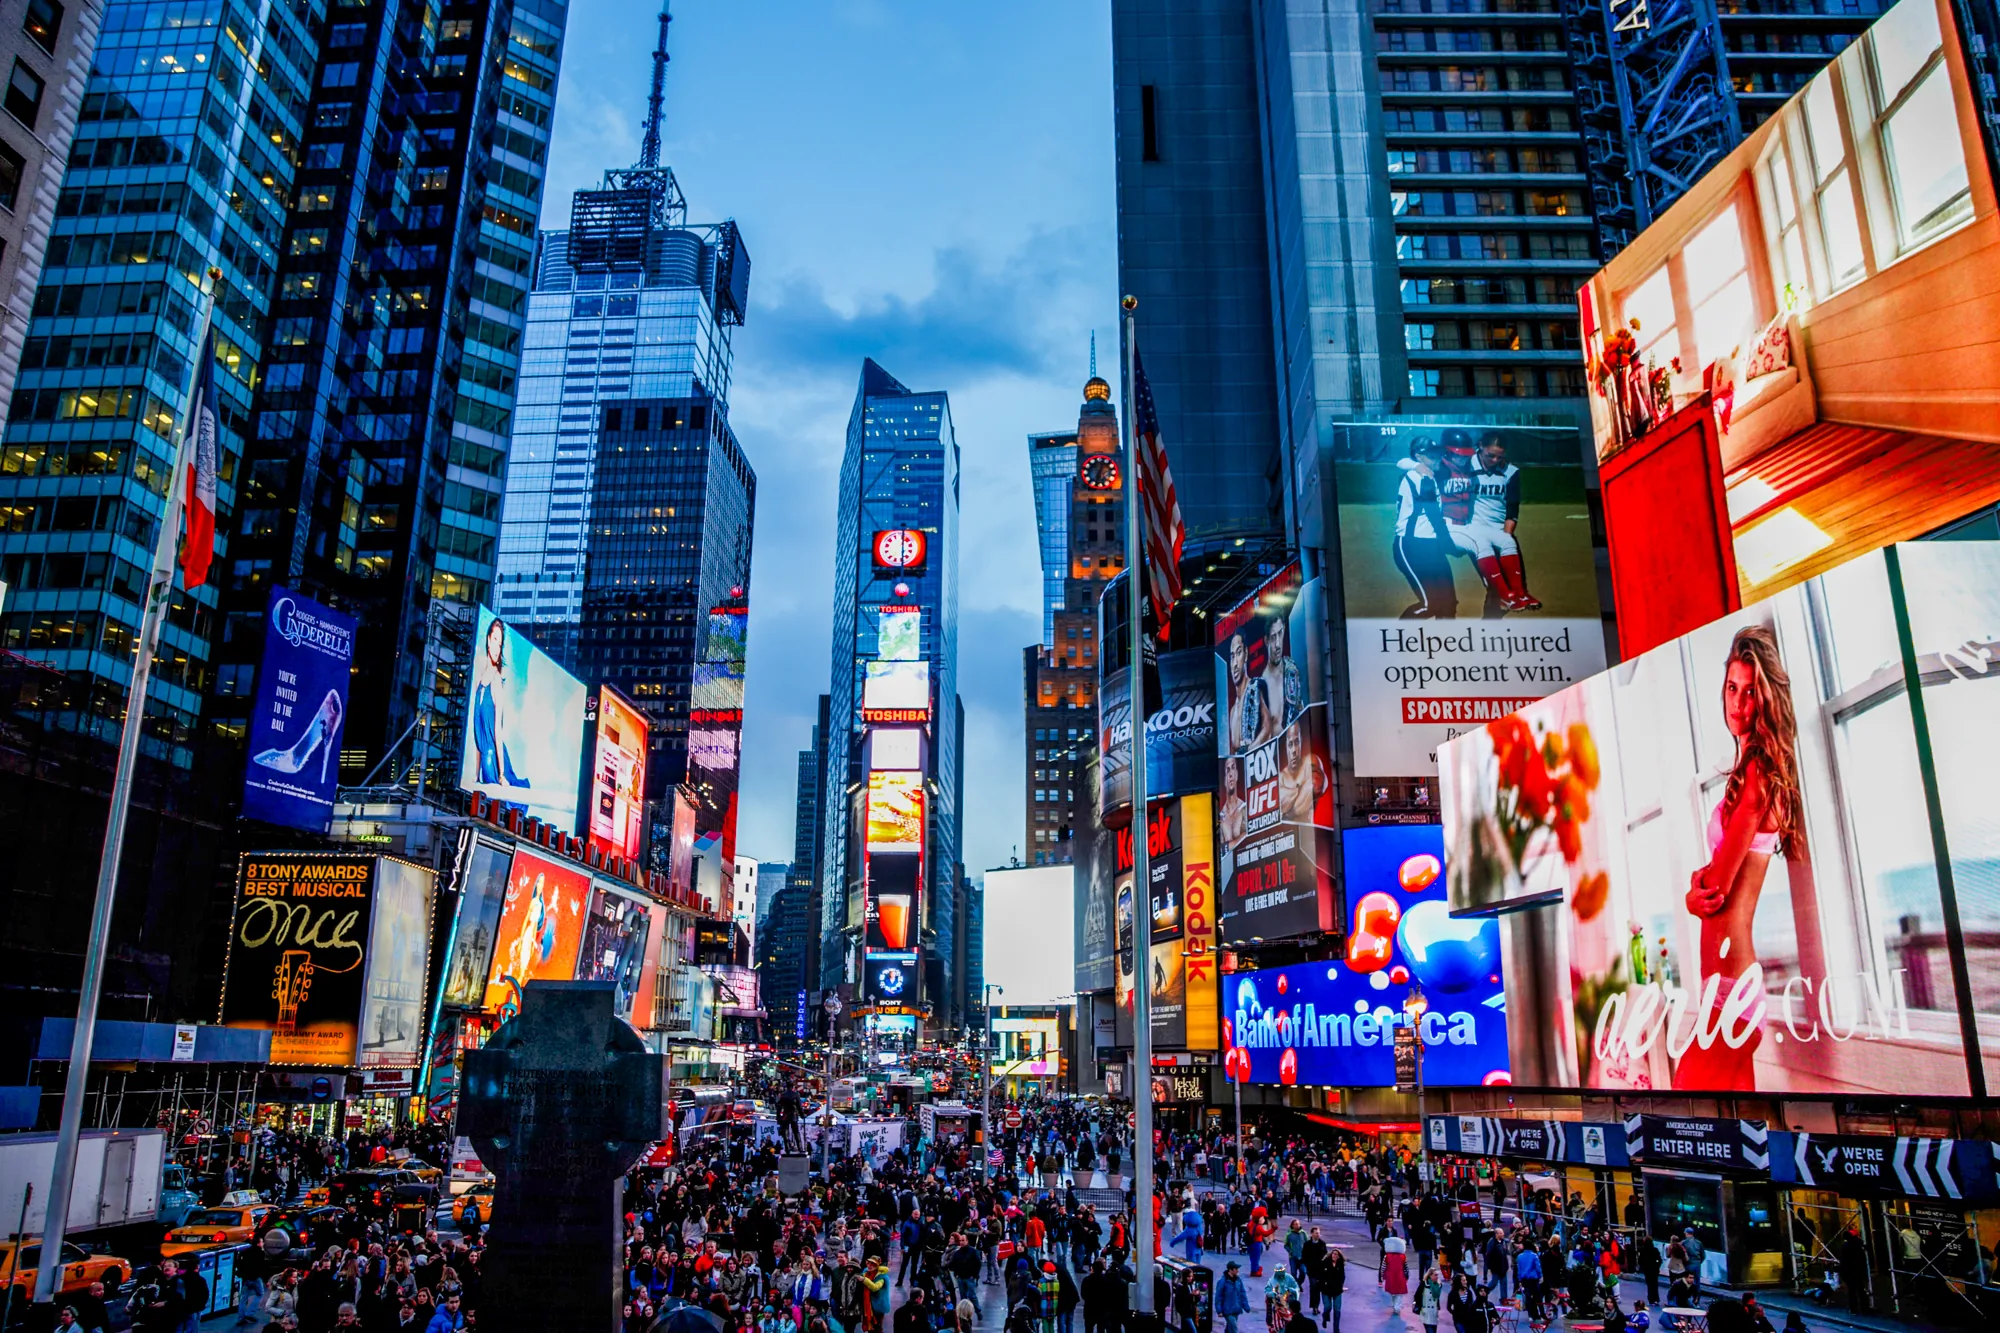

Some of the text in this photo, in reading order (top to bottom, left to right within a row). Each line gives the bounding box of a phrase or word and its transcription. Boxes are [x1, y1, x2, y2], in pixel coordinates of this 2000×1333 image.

[880, 605, 920, 613] TOSHIBA
[272, 597, 351, 656] CINDERELLA
[1380, 627, 1572, 660] Helped injured
[279, 670, 297, 685] YOU'RE
[1384, 658, 1572, 690] opponent win.
[276, 686, 298, 703] INVITED
[273, 702, 293, 718] TO THE
[865, 710, 927, 721] TOSHIBA
[271, 718, 285, 733] BALL
[1157, 726, 1213, 743] emotion
[1247, 742, 1278, 789] FOX
[1249, 780, 1277, 816] UFC
[1248, 811, 1280, 832] SATURDAY
[470, 790, 638, 884] BERTELSMANN
[247, 863, 368, 880] 8 TONY AWARDS
[1237, 867, 1264, 897] APRIL
[1264, 862, 1278, 889] 20
[244, 881, 366, 898] BEST MUSICAL
[1245, 897, 1255, 913] LIVE
[1275, 888, 1289, 906] FOX
[1186, 861, 1213, 983] Kodak
[727, 922, 735, 949] 1500
[1236, 1006, 1281, 1049] Bank
[1281, 1003, 1301, 1048] of
[318, 1031, 344, 1039] AWARD
[1151, 1066, 1207, 1075] ARQUIS
[1177, 1088, 1204, 1101] Hyde
[760, 1125, 775, 1135] Long
[859, 1127, 889, 1140] Wear it.
[1520, 1129, 1542, 1139] WE'RE
[1666, 1121, 1714, 1132] AMERICAN EAGLE
[1676, 1130, 1704, 1138] OUTFITTERS
[879, 1136, 888, 1144] it.
[1521, 1140, 1540, 1150] OPEN
[1653, 1138, 1732, 1158] ENTER HERE
[1842, 1146, 1884, 1162] WE'RE
[1844, 1162, 1880, 1177] OPEN
